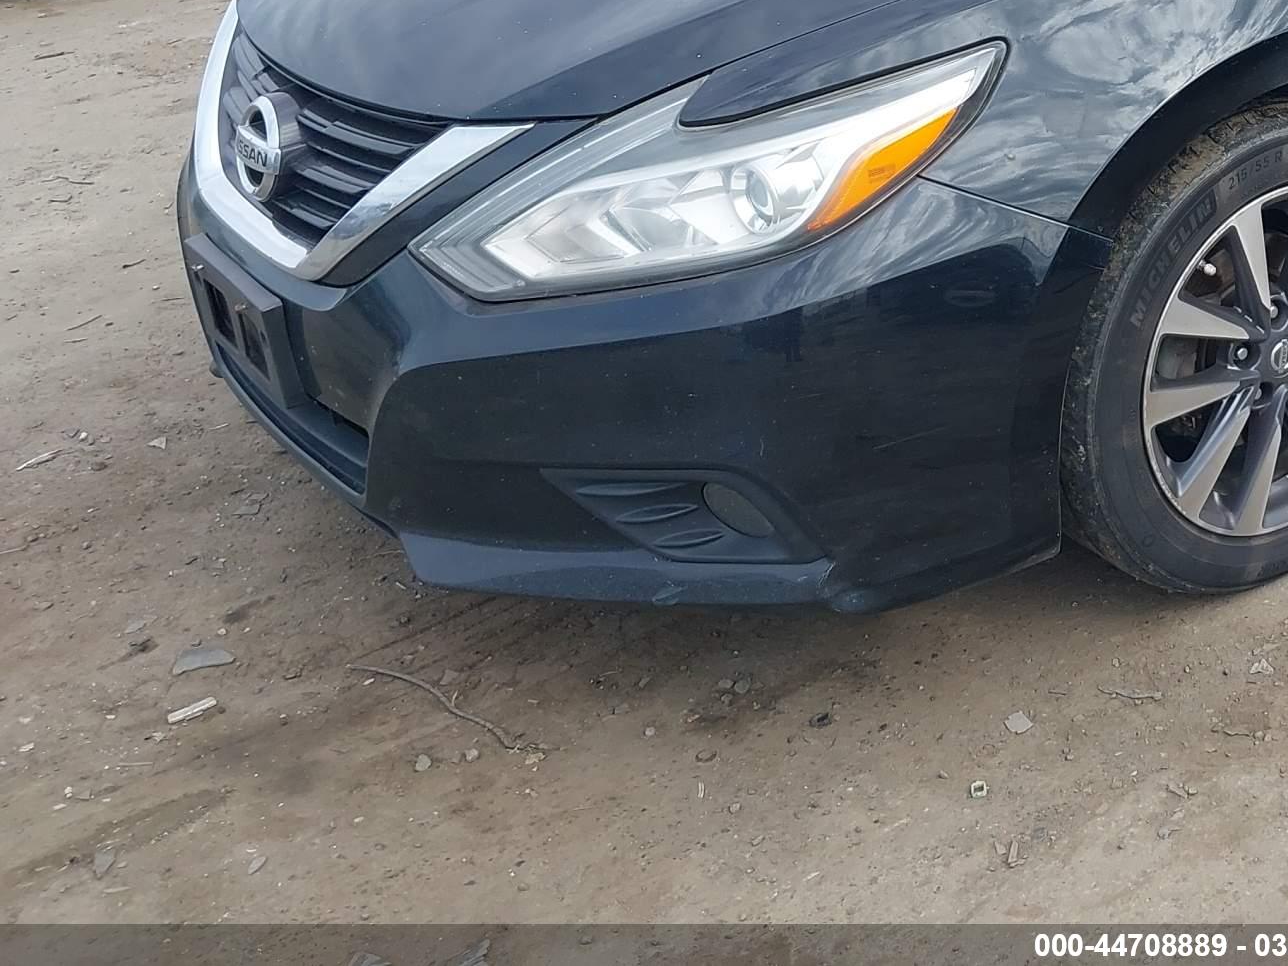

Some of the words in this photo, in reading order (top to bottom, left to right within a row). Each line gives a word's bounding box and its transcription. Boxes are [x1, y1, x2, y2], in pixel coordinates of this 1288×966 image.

[237, 139, 268, 167] SSAN
[1274, 149, 1283, 163] R
[1130, 196, 1214, 327] MICHELIN
